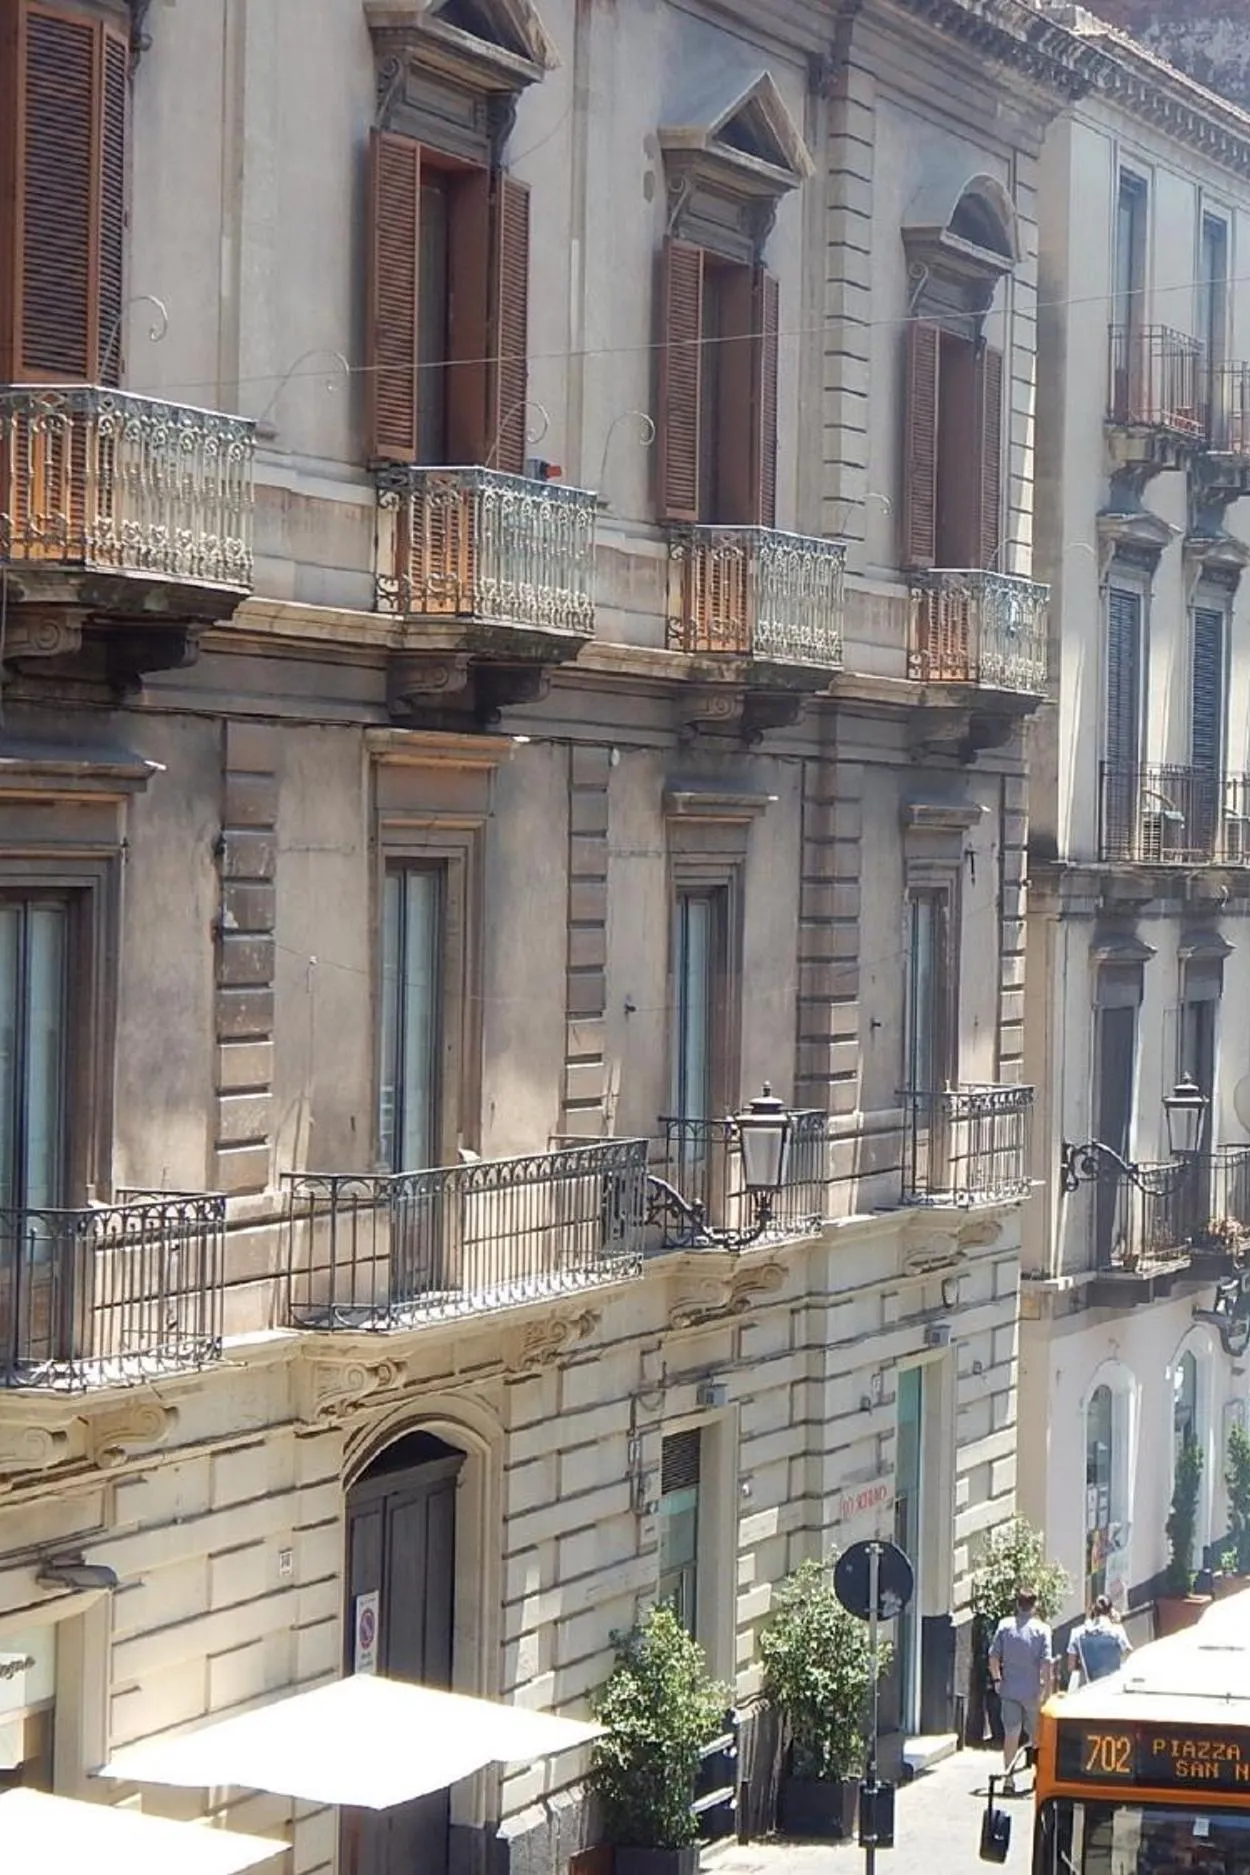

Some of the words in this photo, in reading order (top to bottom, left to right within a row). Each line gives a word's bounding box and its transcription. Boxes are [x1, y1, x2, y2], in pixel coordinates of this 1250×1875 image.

[1086, 1735, 1131, 1773] 702
[1152, 1738, 1240, 1761] PIAZZA
[1176, 1760, 1219, 1778] SAN
